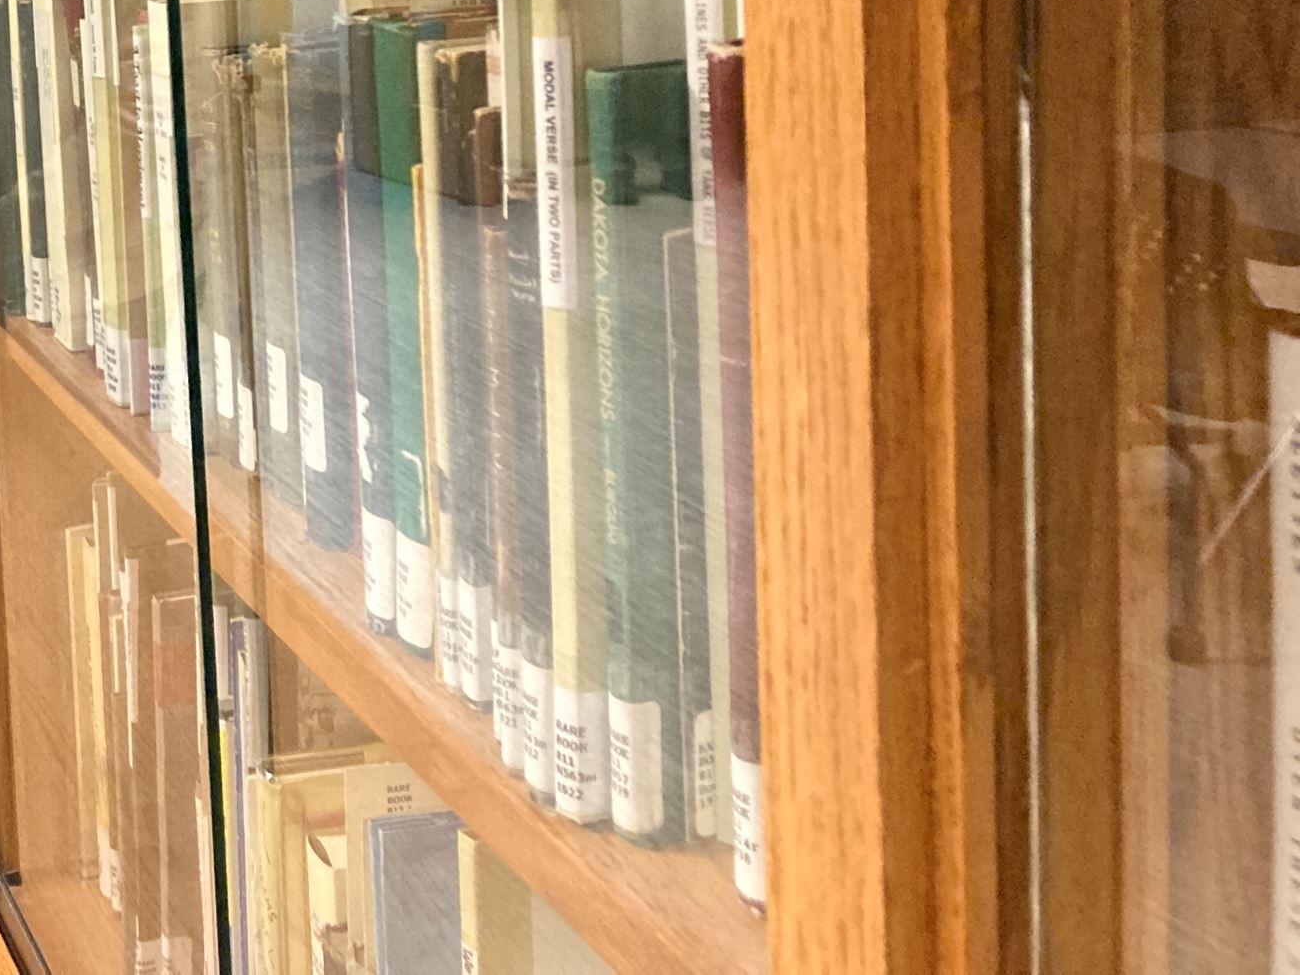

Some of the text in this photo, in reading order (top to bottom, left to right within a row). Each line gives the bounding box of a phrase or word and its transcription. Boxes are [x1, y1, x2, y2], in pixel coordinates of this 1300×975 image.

[697, 37, 708, 60] AND
[698, 66, 710, 105] OTHER
[544, 60, 562, 285] MODAL VERSE (IN TWO PARTS)
[591, 177, 610, 281] DAKOTA
[596, 293, 616, 421] HORIZONS
[556, 718, 587, 739] RARE
[556, 734, 589, 754] BOOK
[386, 784, 411, 794] RARE
[387, 794, 414, 805] BOOK
